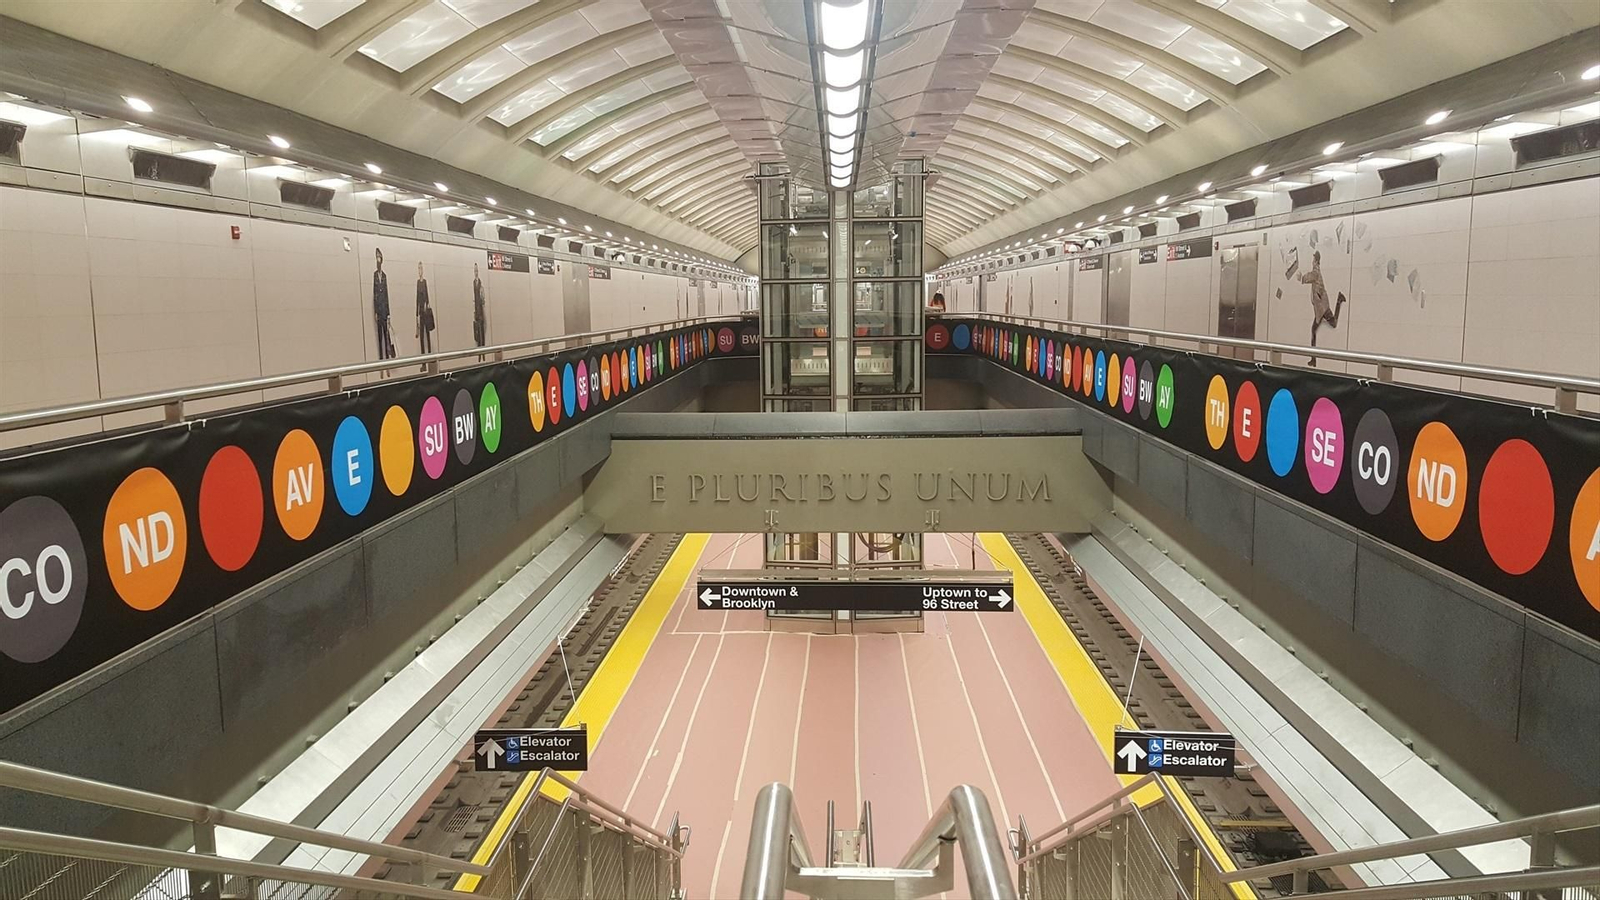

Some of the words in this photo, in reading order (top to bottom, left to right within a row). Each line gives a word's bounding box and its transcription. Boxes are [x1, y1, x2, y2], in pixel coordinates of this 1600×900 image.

[720, 335, 732, 345] SU
[742, 334, 759, 344] BW
[934, 332, 942, 342] E
[531, 391, 543, 414] TH
[551, 386, 557, 407] E
[579, 376, 587, 396] SE
[591, 372, 599, 391] CO
[631, 361, 636, 376] E
[1098, 367, 1103, 386] E
[1124, 376, 1134, 396] SU
[1139, 379, 1152, 403] BW
[1159, 386, 1171, 409] AY
[1210, 398, 1225, 429] TH
[1242, 408, 1252, 438] E
[1311, 427, 1336, 467] SE
[1358, 441, 1391, 486] CO
[1416, 458, 1457, 508] ND
[650, 474, 667, 503] E
[688, 472, 893, 503] PLURIBUS
[913, 472, 1053, 503] UNUM
[0, 544, 73, 619] CO
[118, 511, 175, 575] ND
[285, 462, 314, 511] AV
[346, 448, 361, 487] E
[424, 422, 443, 456] SU
[455, 412, 474, 444] BW
[485, 404, 497, 433] AY
[721, 586, 787, 597] Downtown
[789, 586, 799, 597] &
[922, 587, 971, 600] Uptown
[974, 588, 988, 598] to
[722, 598, 776, 610] Brooklyn
[922, 598, 938, 609] 96
[940, 599, 979, 610] Street
[520, 736, 572, 747] Elevator
[1163, 739, 1220, 752] Elevator
[520, 750, 580, 761] Escalator
[1163, 754, 1228, 766] Escalator
